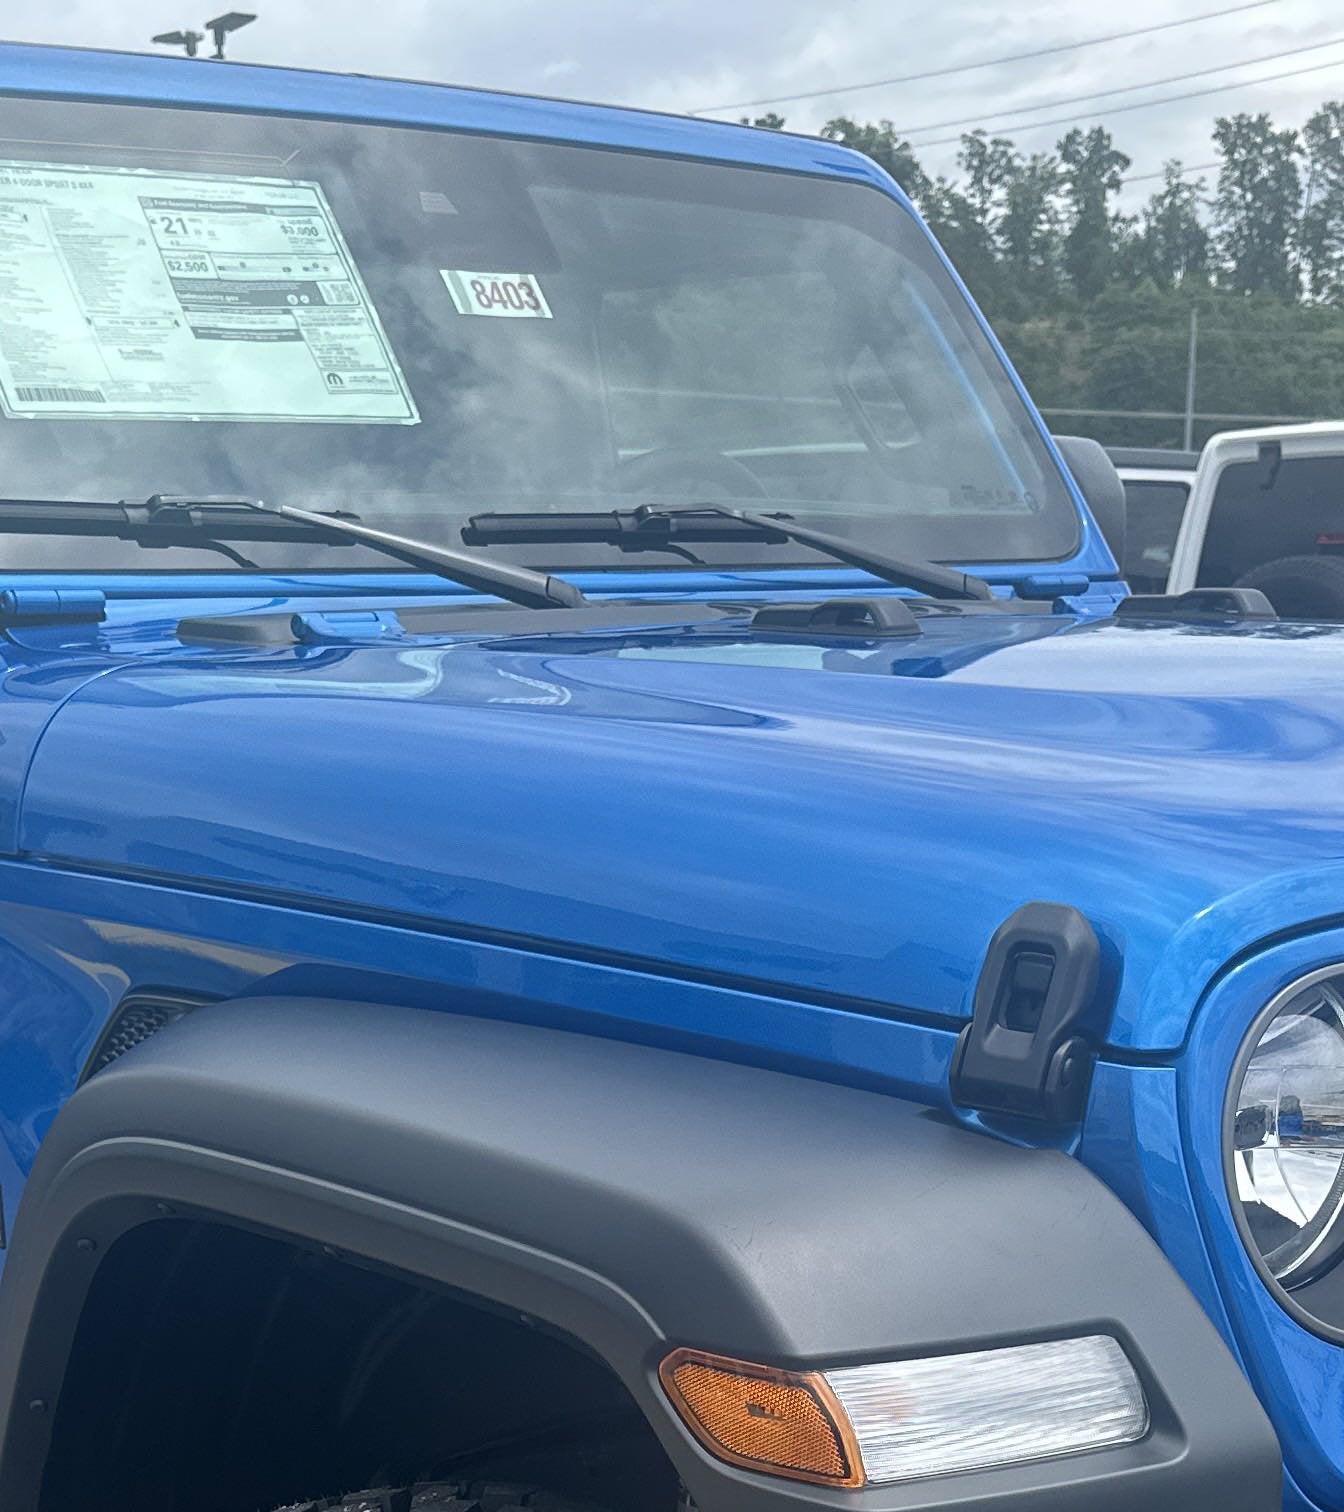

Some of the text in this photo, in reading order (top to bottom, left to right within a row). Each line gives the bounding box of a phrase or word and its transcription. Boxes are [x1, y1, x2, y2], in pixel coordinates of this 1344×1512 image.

[160, 216, 189, 236] 21
[167, 260, 209, 273] $2,500
[469, 279, 541, 311] 8403
